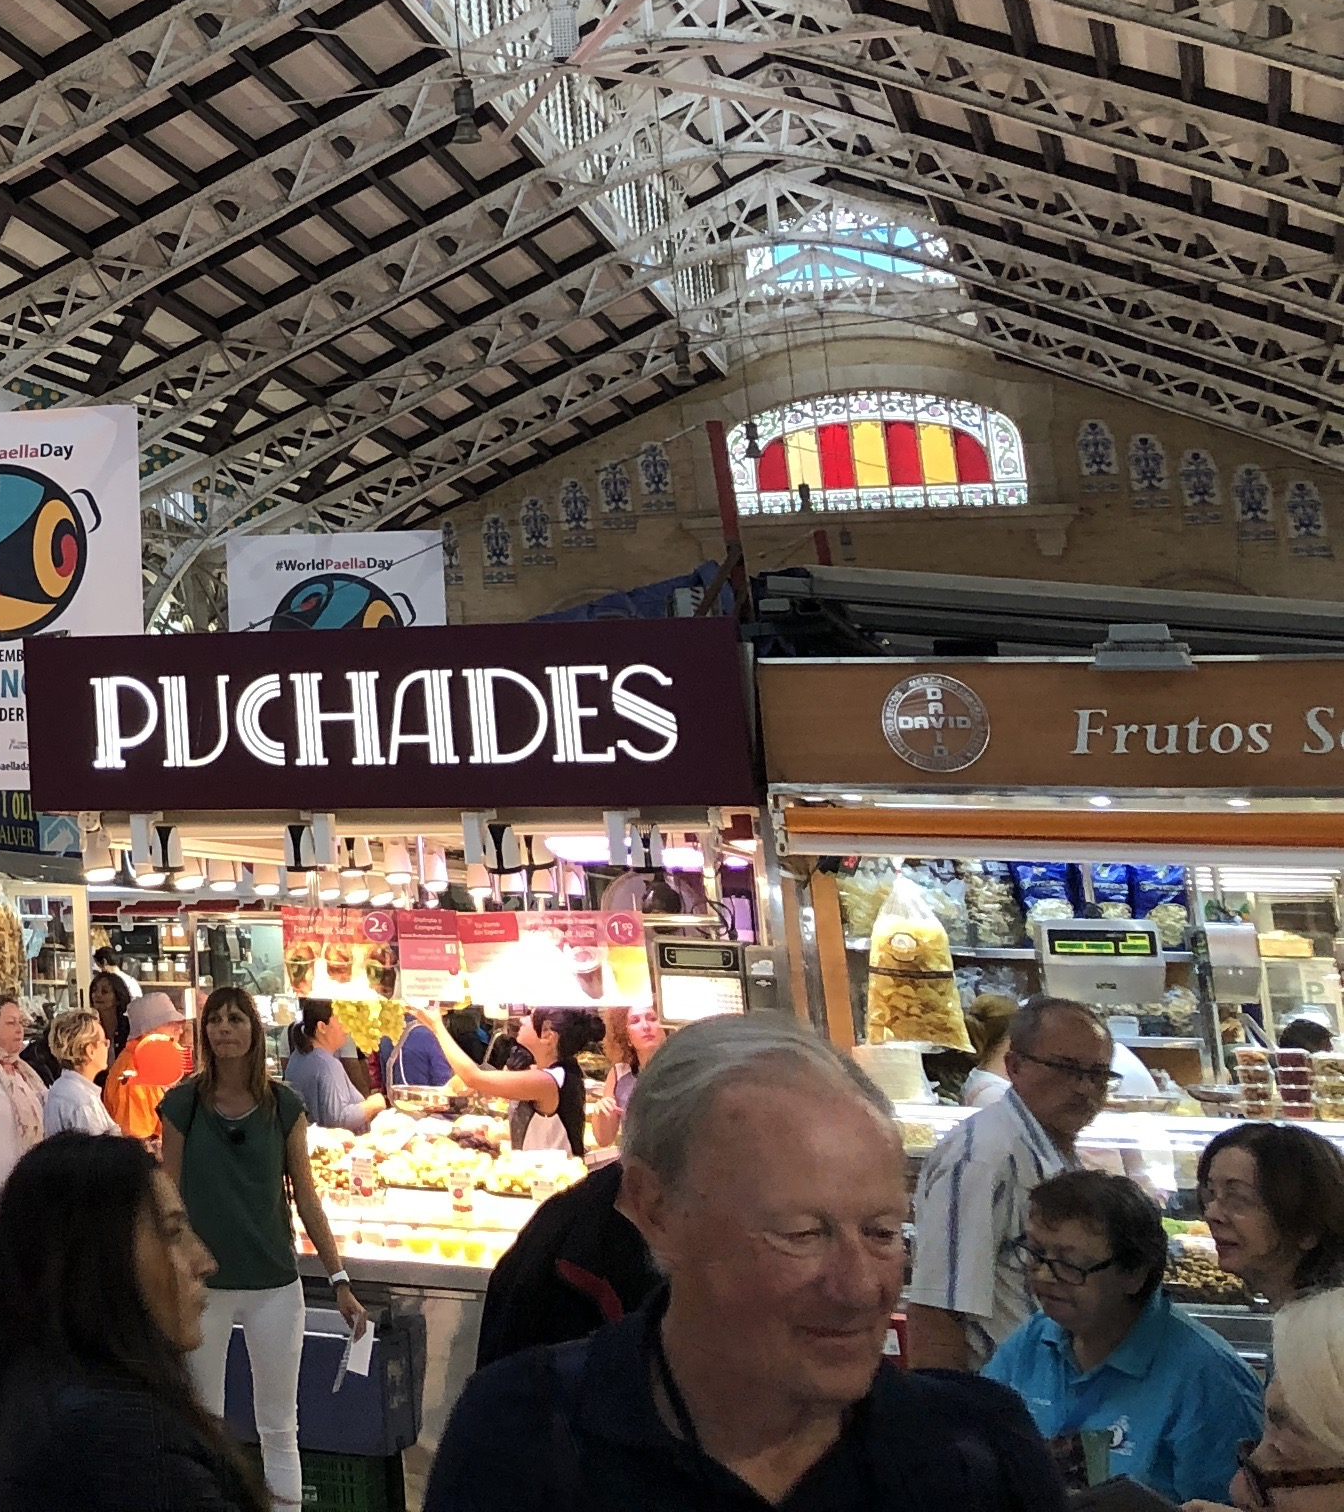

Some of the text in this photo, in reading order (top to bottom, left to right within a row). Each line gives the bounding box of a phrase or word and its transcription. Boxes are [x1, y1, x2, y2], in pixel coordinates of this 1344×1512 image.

[275, 557, 394, 571] #WorldPaellaDay
[0, 708, 25, 722] DER
[90, 664, 678, 768] PUCHADES
[898, 716, 972, 729] DAVID
[1068, 706, 1344, 755] Frutos S
